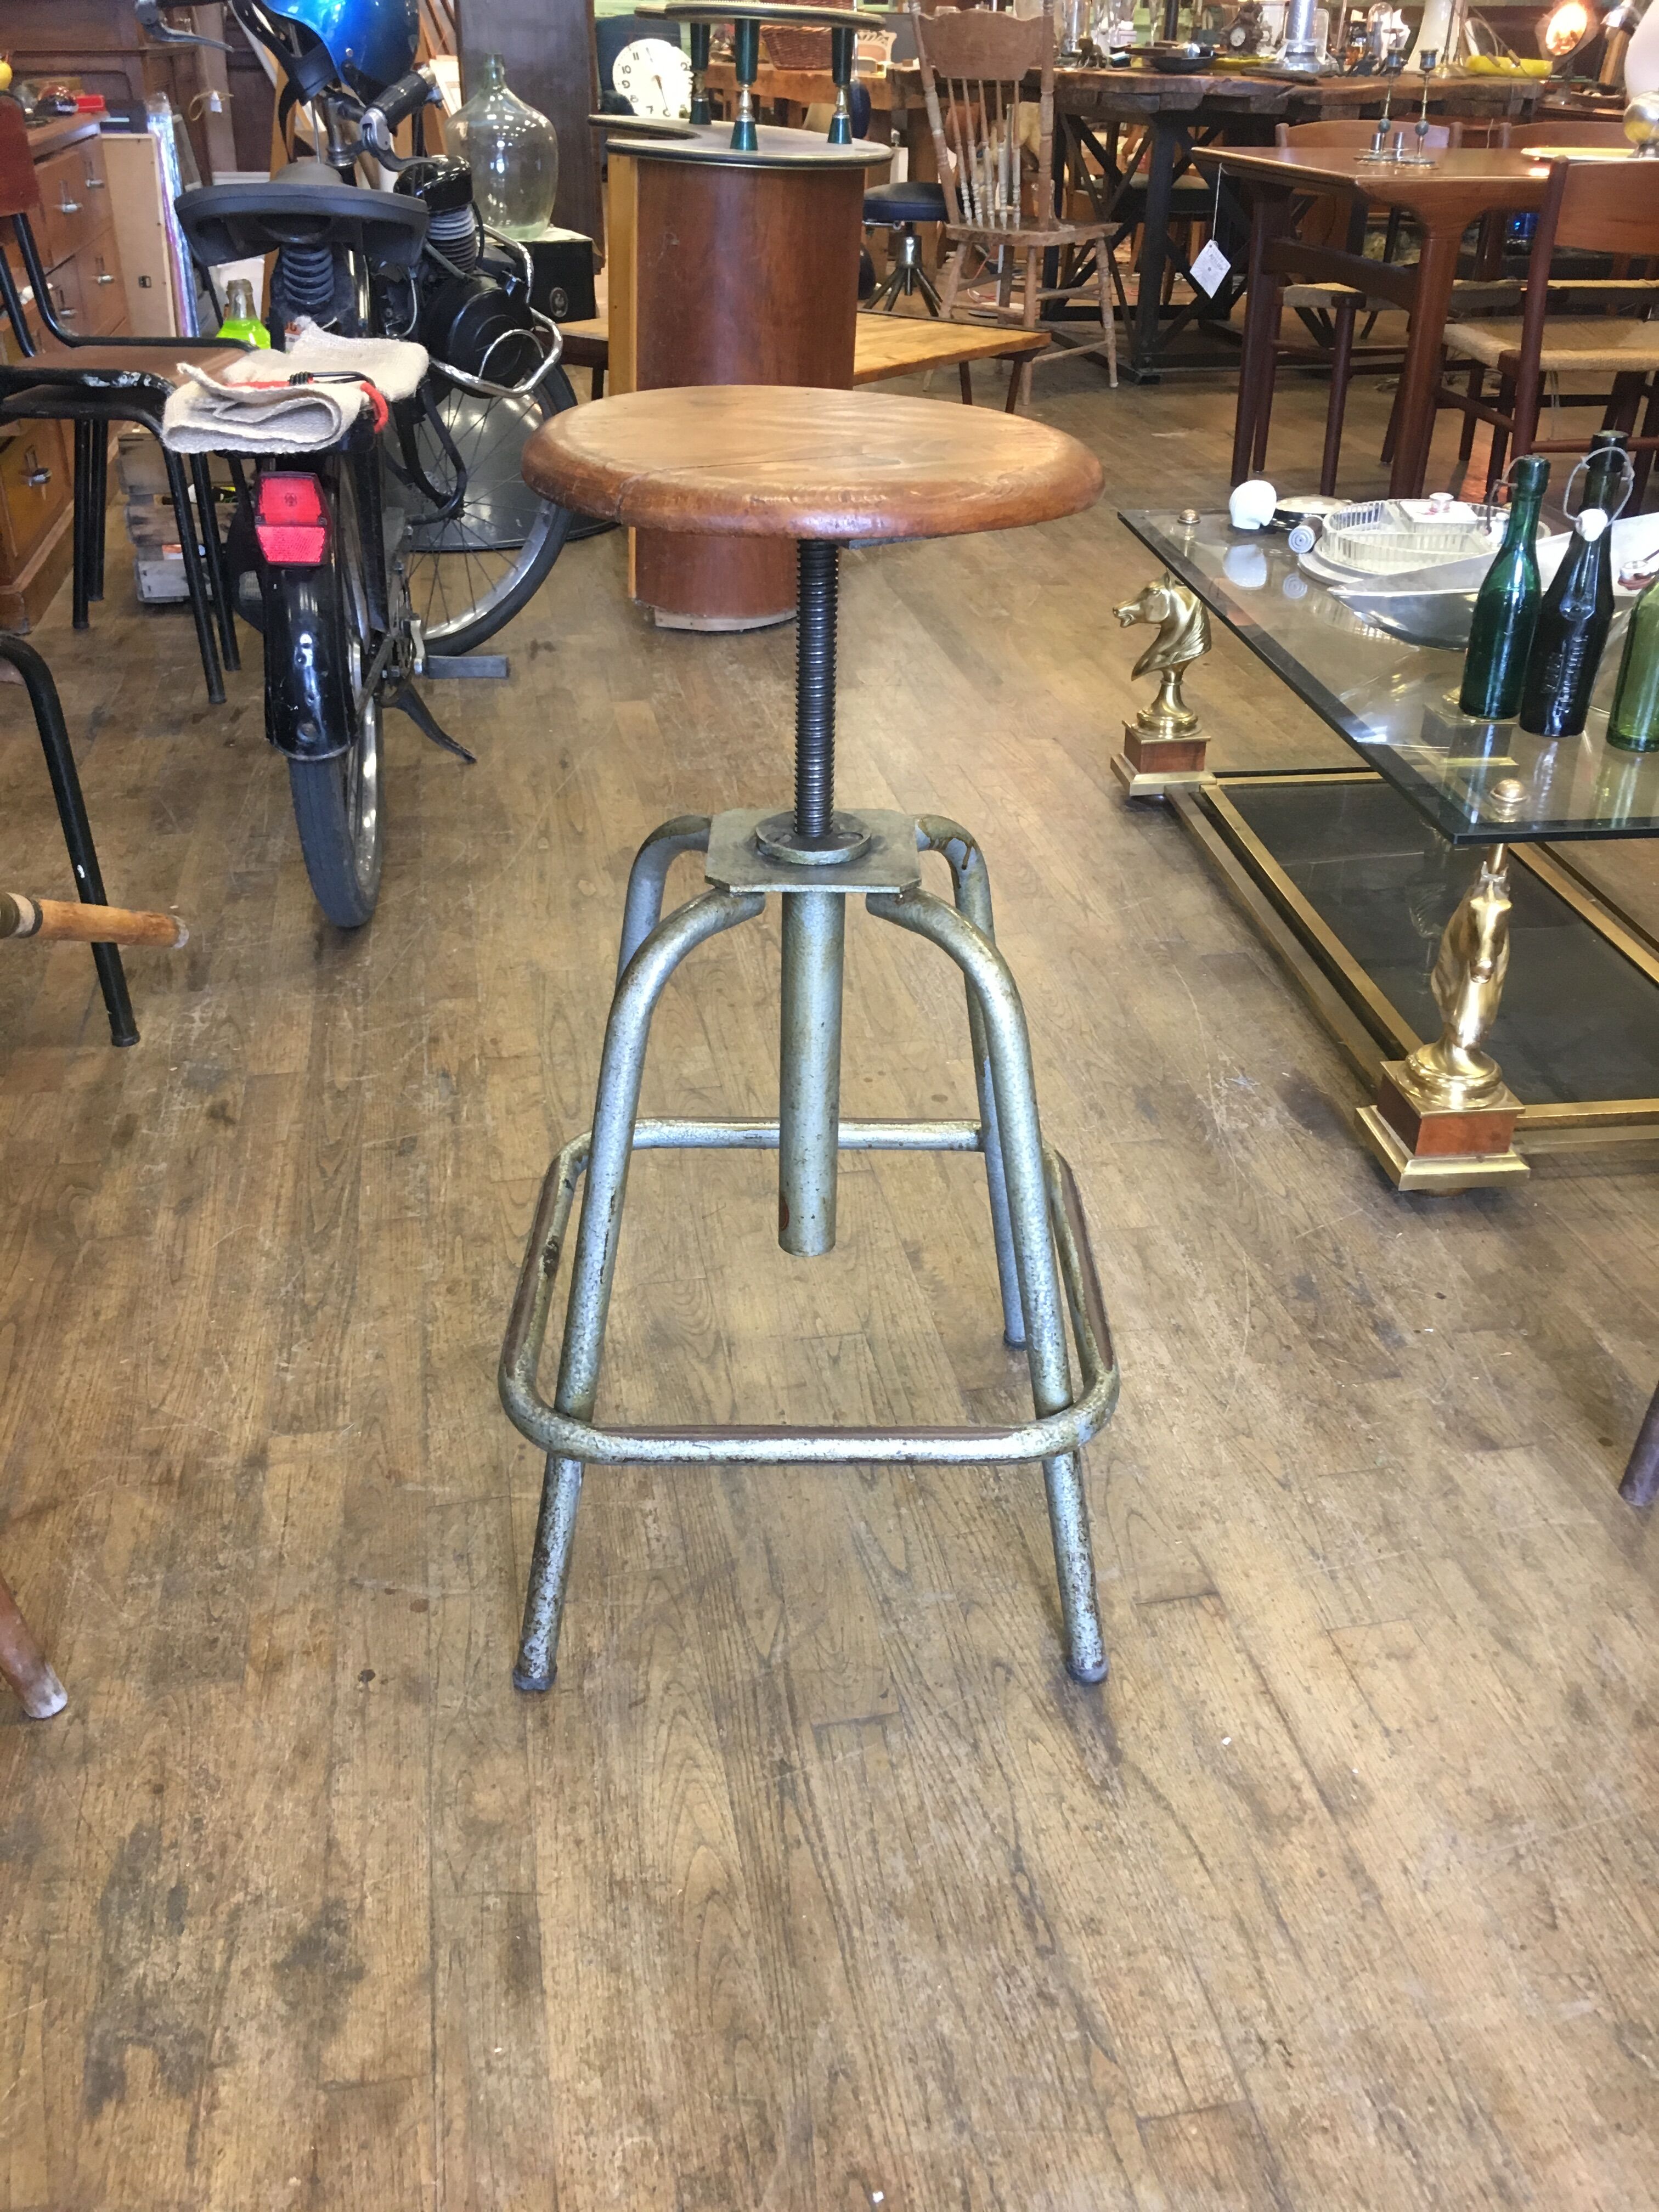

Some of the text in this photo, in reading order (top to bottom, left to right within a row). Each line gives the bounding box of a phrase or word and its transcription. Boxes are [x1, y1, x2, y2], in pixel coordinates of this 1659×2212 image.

[633, 52, 640, 60] 11
[622, 65, 631, 74] 10
[680, 62, 690, 71] 2
[622, 80, 630, 89] 9
[630, 94, 639, 103] 8
[646, 105, 654, 114] 7
